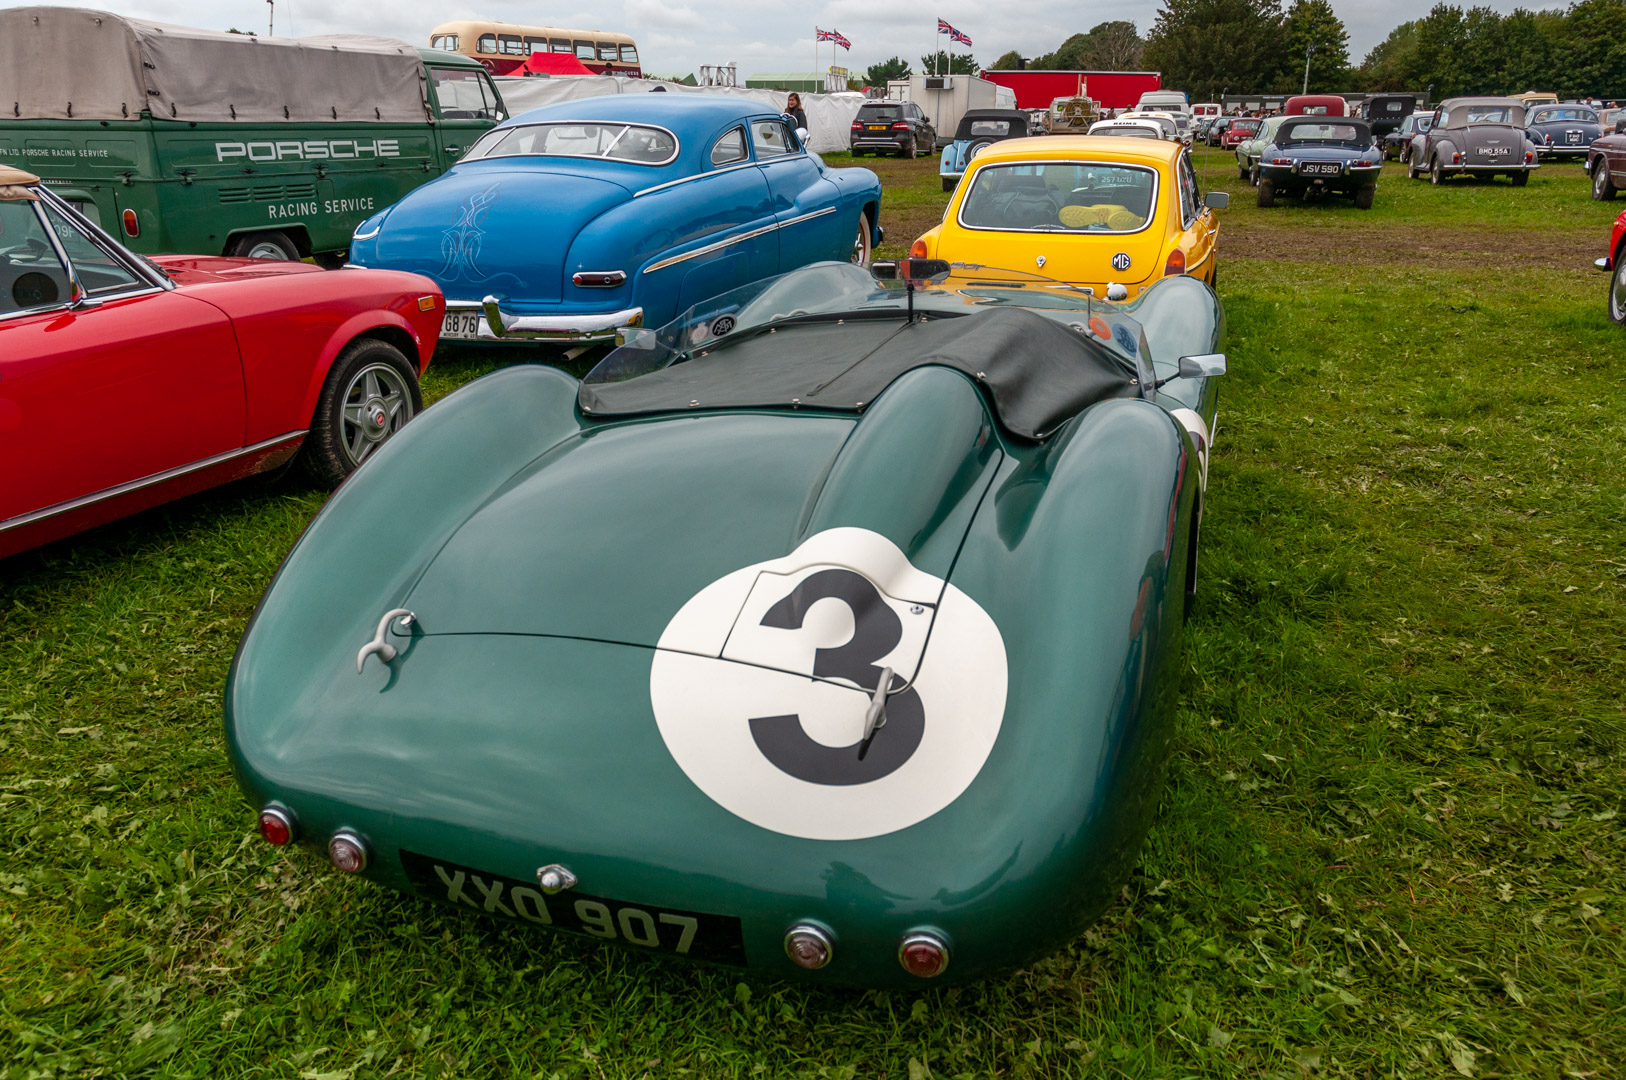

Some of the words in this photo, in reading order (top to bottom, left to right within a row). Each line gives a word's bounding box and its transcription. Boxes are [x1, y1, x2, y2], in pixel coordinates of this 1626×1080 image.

[22, 149, 49, 157] PORSCHE
[51, 149, 76, 157] RACING
[78, 149, 108, 158] SERVICE
[215, 140, 400, 161] PORSCHE
[1303, 165, 1320, 173] JSV
[1321, 165, 1339, 173] 590
[268, 202, 318, 219] RACING
[325, 197, 374, 214] SERVICE
[1113, 254, 1130, 270] MG
[748, 568, 926, 786] 3
[433, 864, 552, 925] XXO
[574, 899, 698, 953] 907
